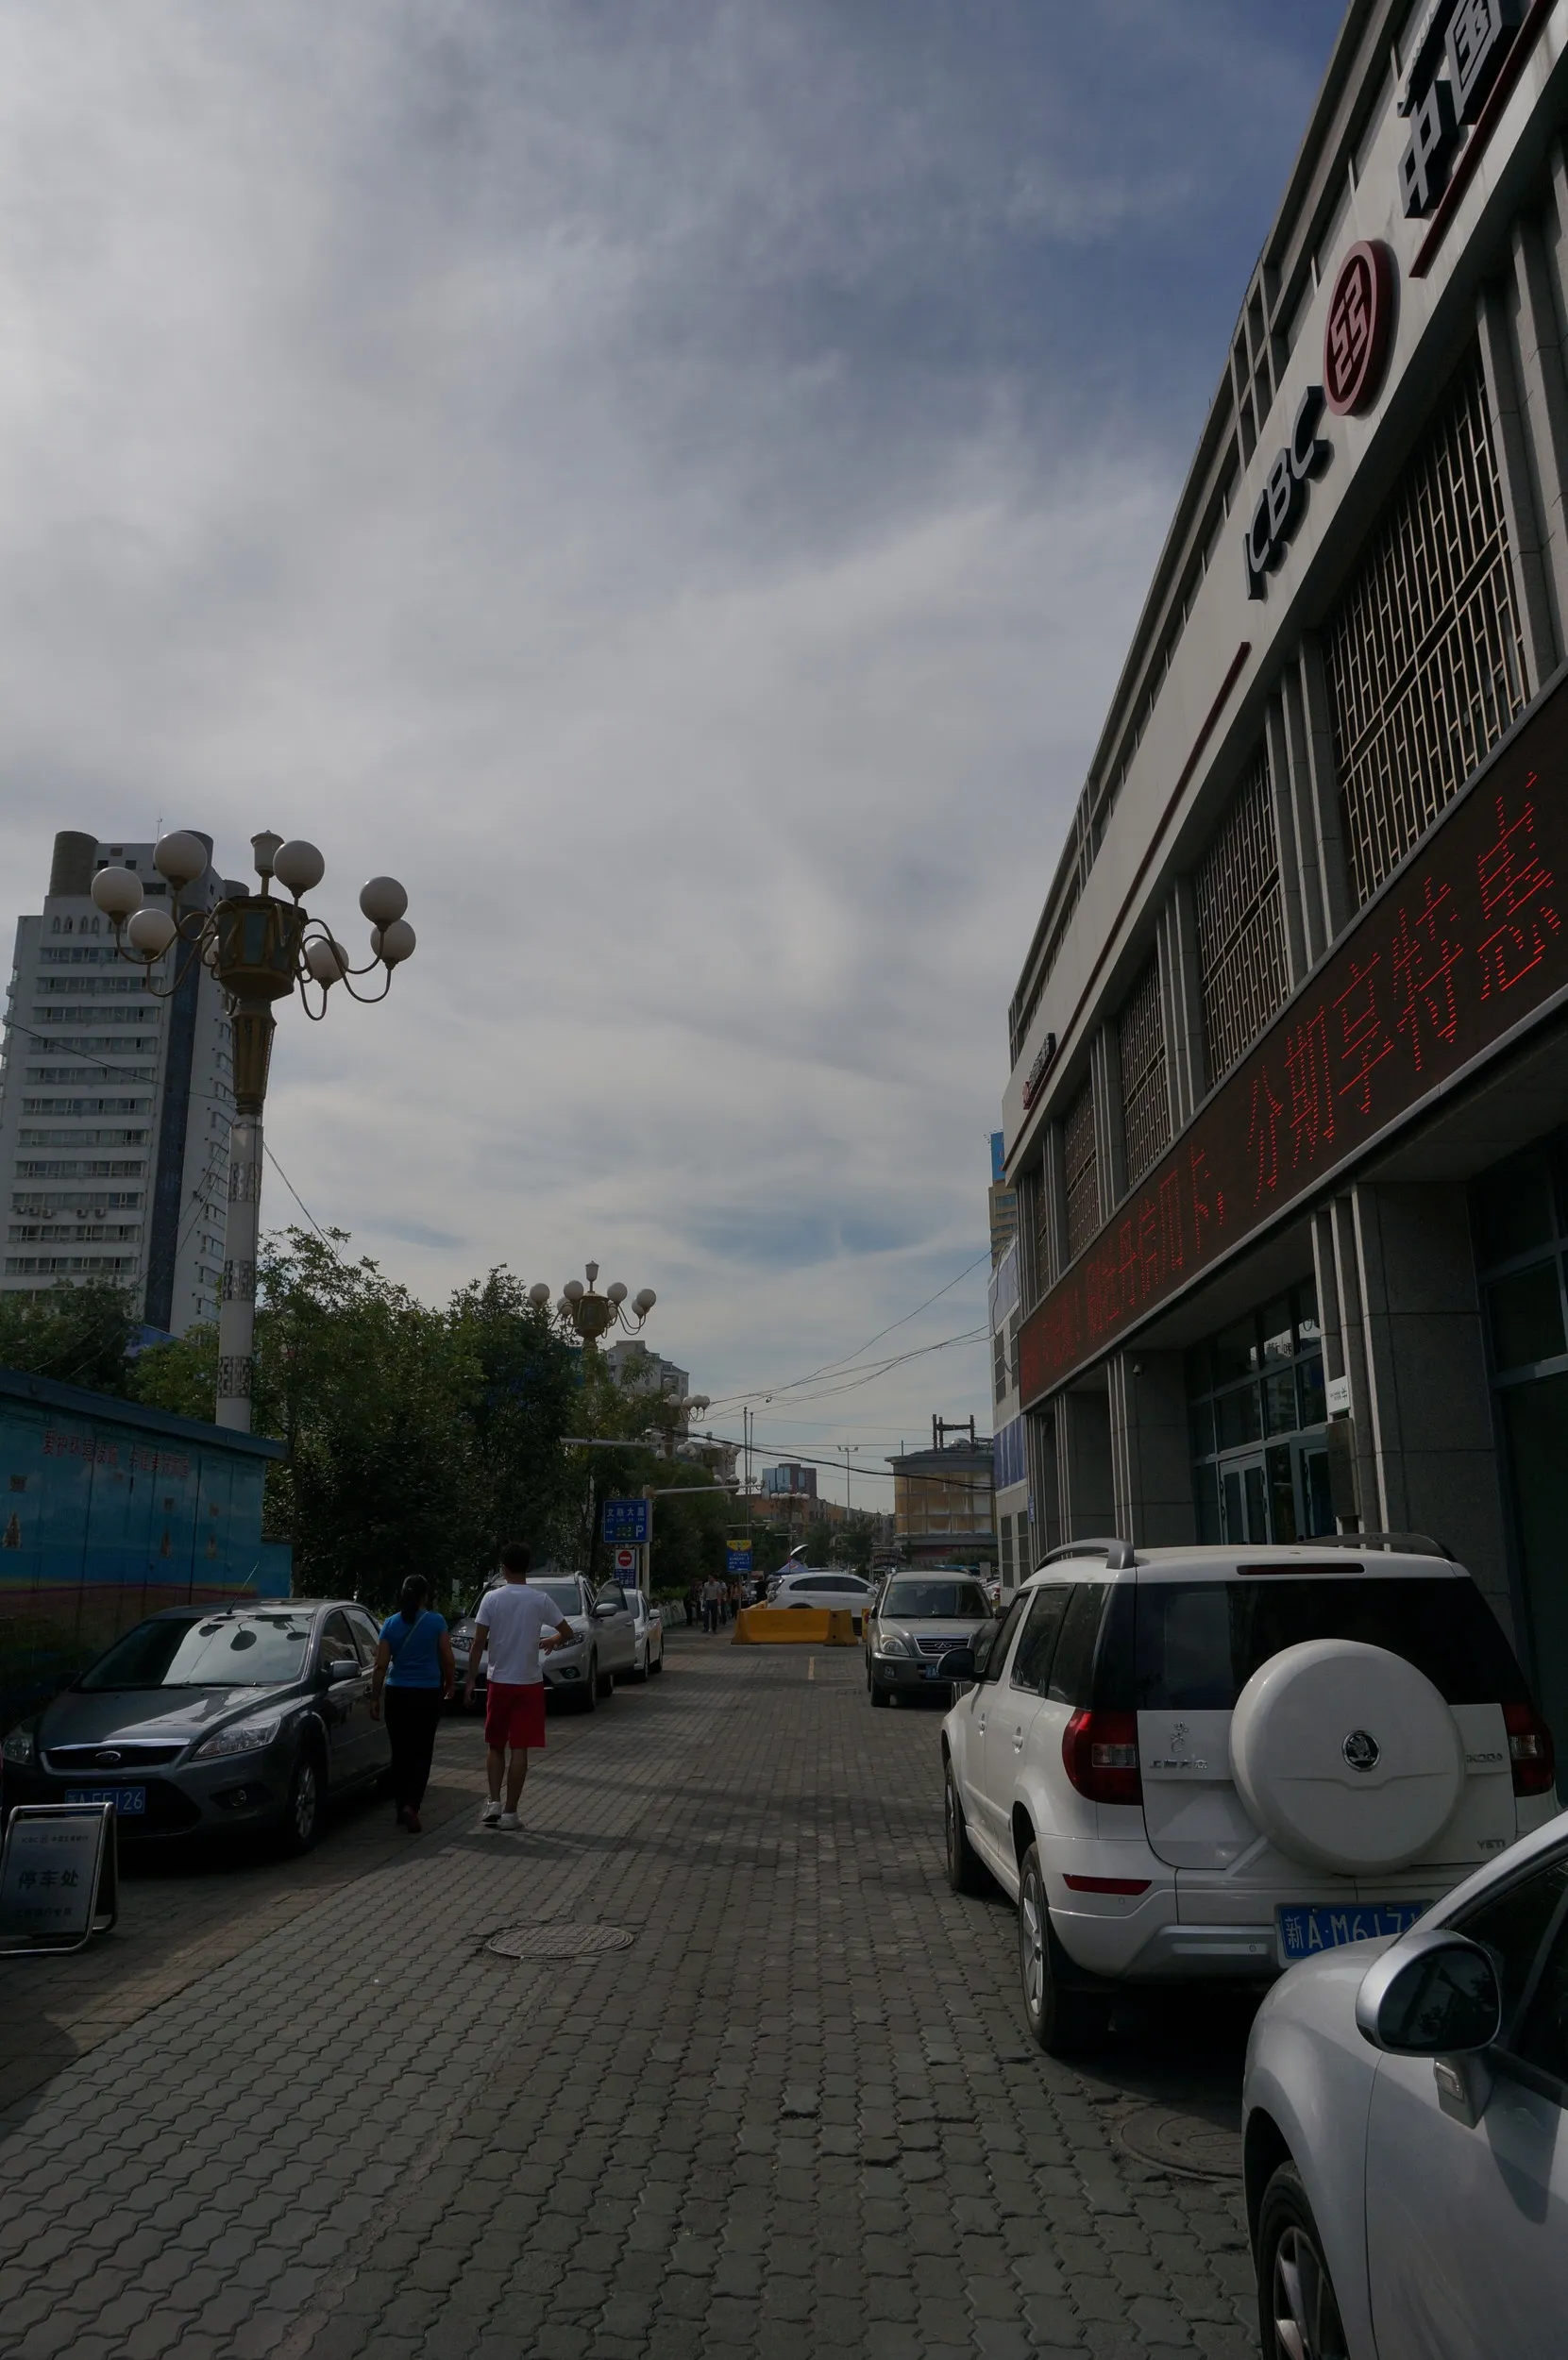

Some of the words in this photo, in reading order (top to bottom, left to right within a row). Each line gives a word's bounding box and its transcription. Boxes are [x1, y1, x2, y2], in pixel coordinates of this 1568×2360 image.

[1243, 385, 1325, 599] ICBC
[635, 1525, 644, 1537] P
[19, 1869, 78, 1891] 停车处
